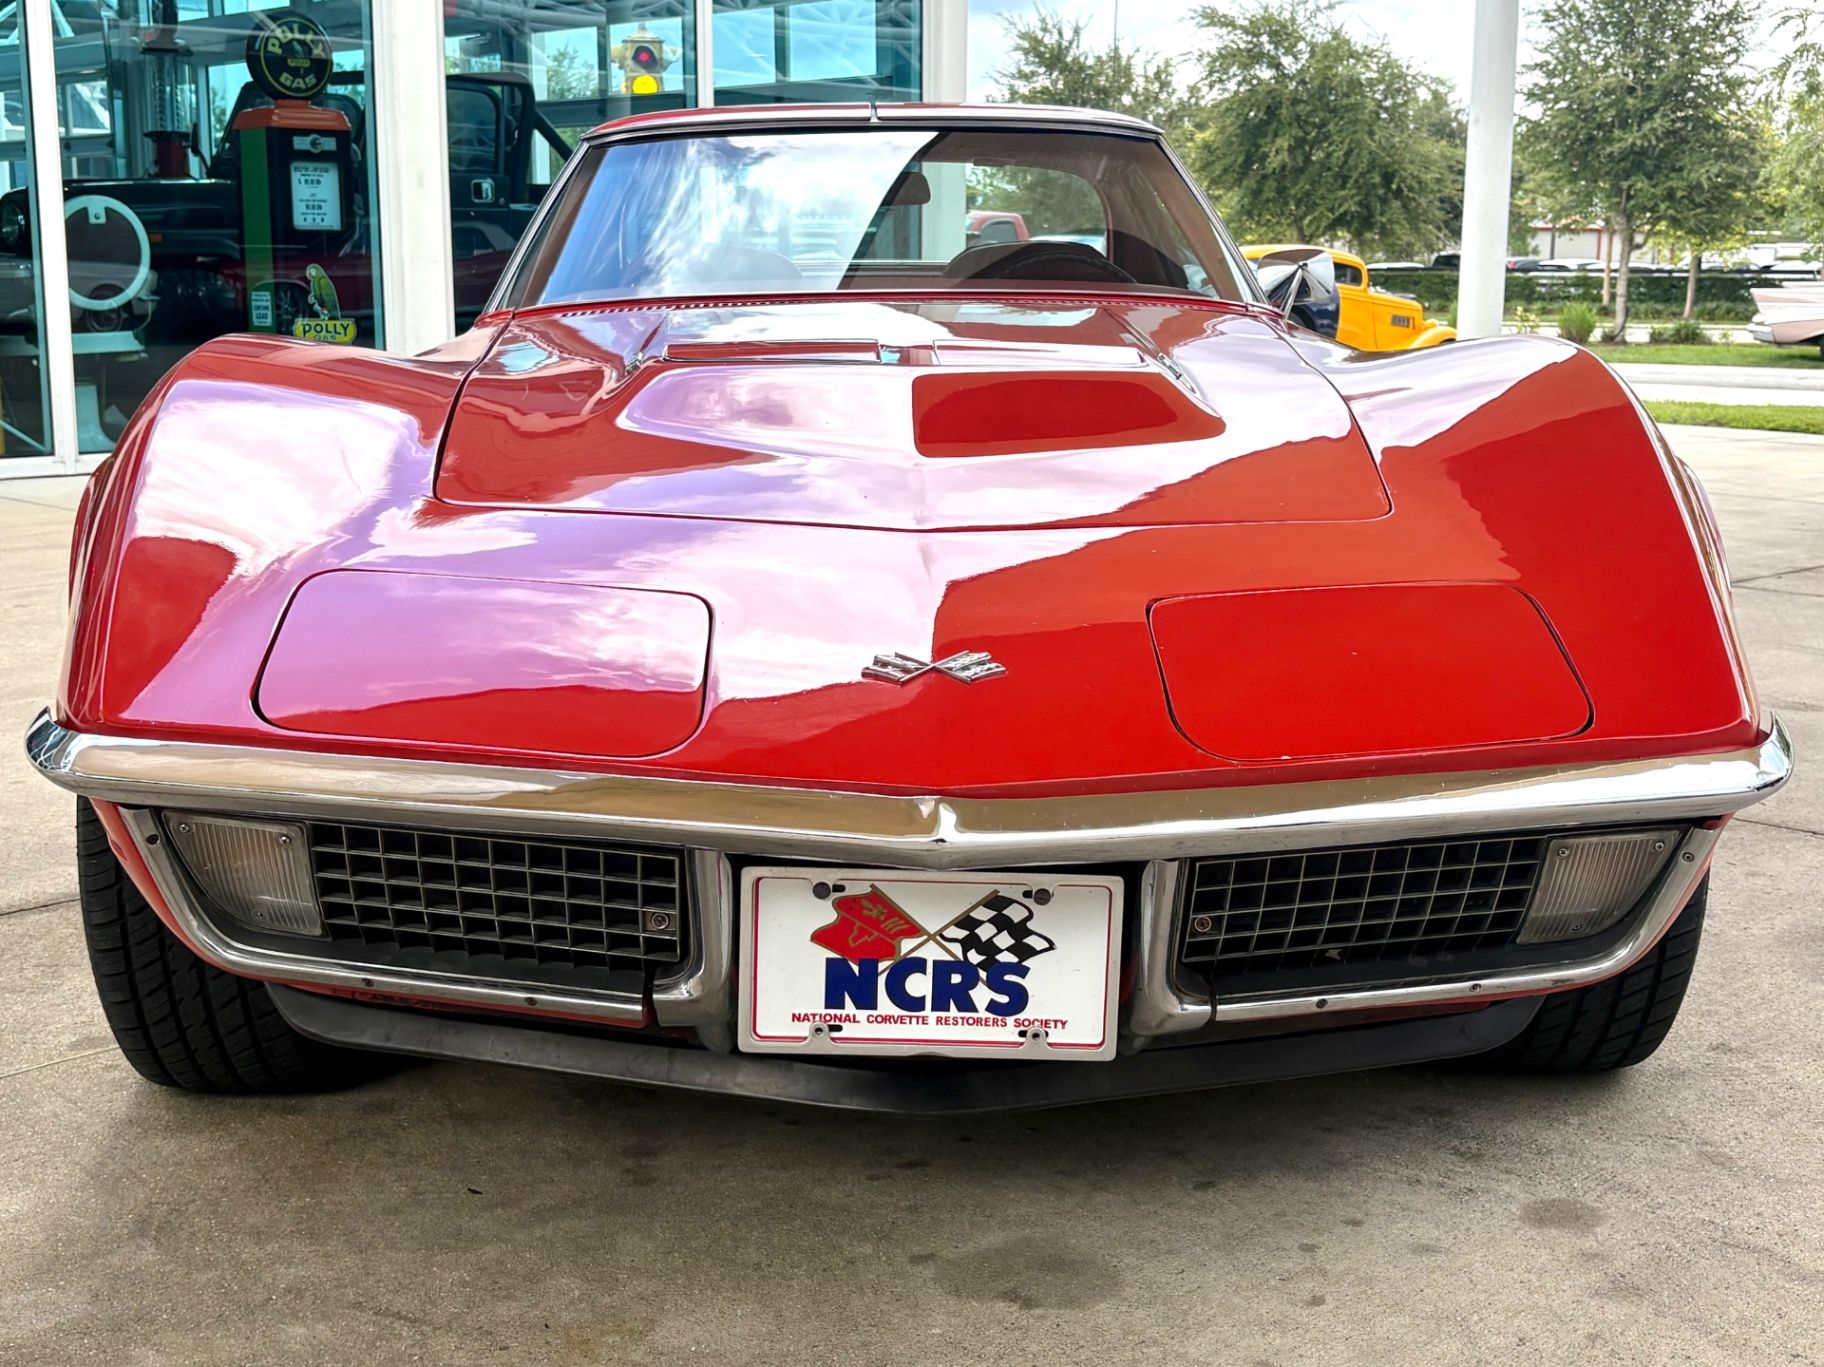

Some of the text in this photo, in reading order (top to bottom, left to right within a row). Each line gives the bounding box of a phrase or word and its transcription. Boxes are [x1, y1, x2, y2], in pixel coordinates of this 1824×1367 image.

[279, 72, 317, 90] GAS
[302, 322, 350, 337] POLLY
[824, 957, 1031, 1017] NCRS
[791, 1012, 1069, 1030] NATIONAL CORVETTE RESTORERS SOCIETY
